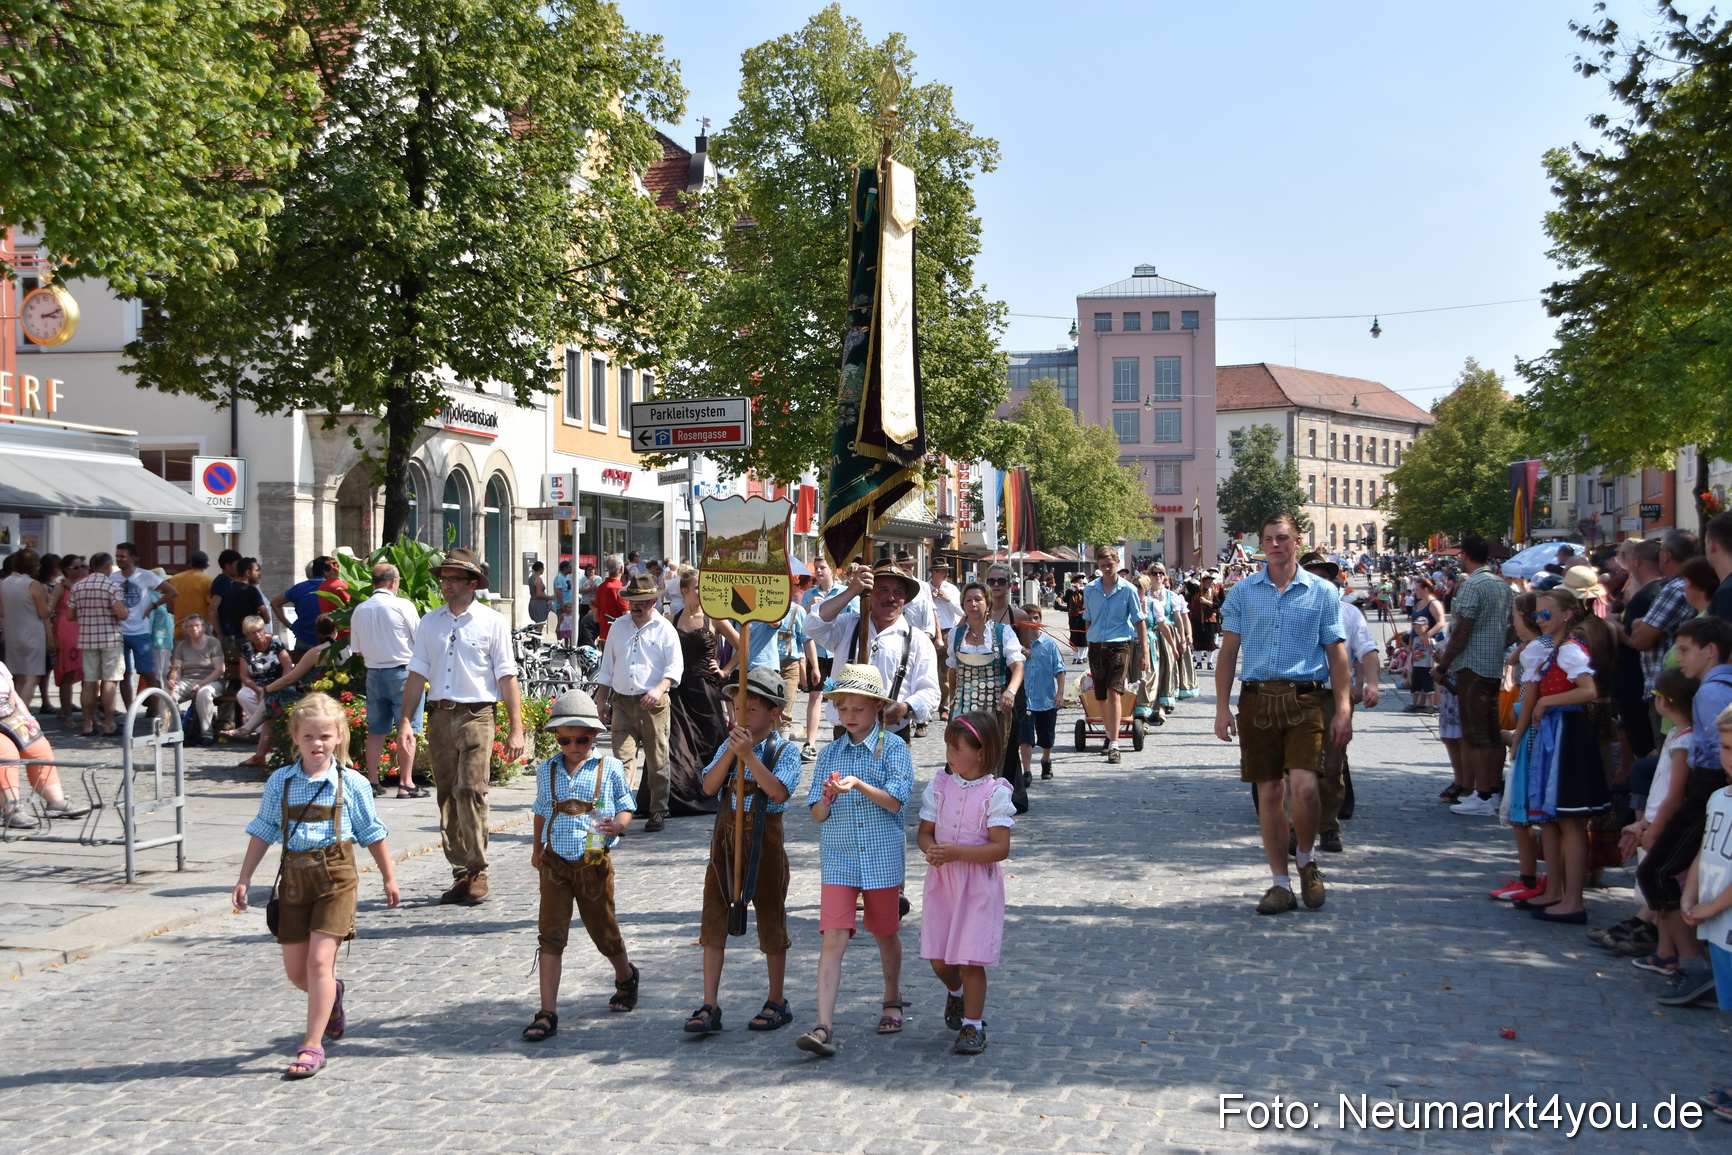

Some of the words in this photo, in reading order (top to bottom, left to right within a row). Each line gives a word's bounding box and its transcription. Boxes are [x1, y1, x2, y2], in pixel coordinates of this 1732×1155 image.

[650, 406, 726, 421] Parkleitsystem
[677, 430, 728, 442] Rosengasse
[659, 472, 687, 483] Rosengasse
[960, 462, 969, 528] TZGEREI
[206, 496, 233, 506] ZONE
[1152, 504, 1183, 513] kasse
[711, 574, 773, 585] ROHRENSTADT
